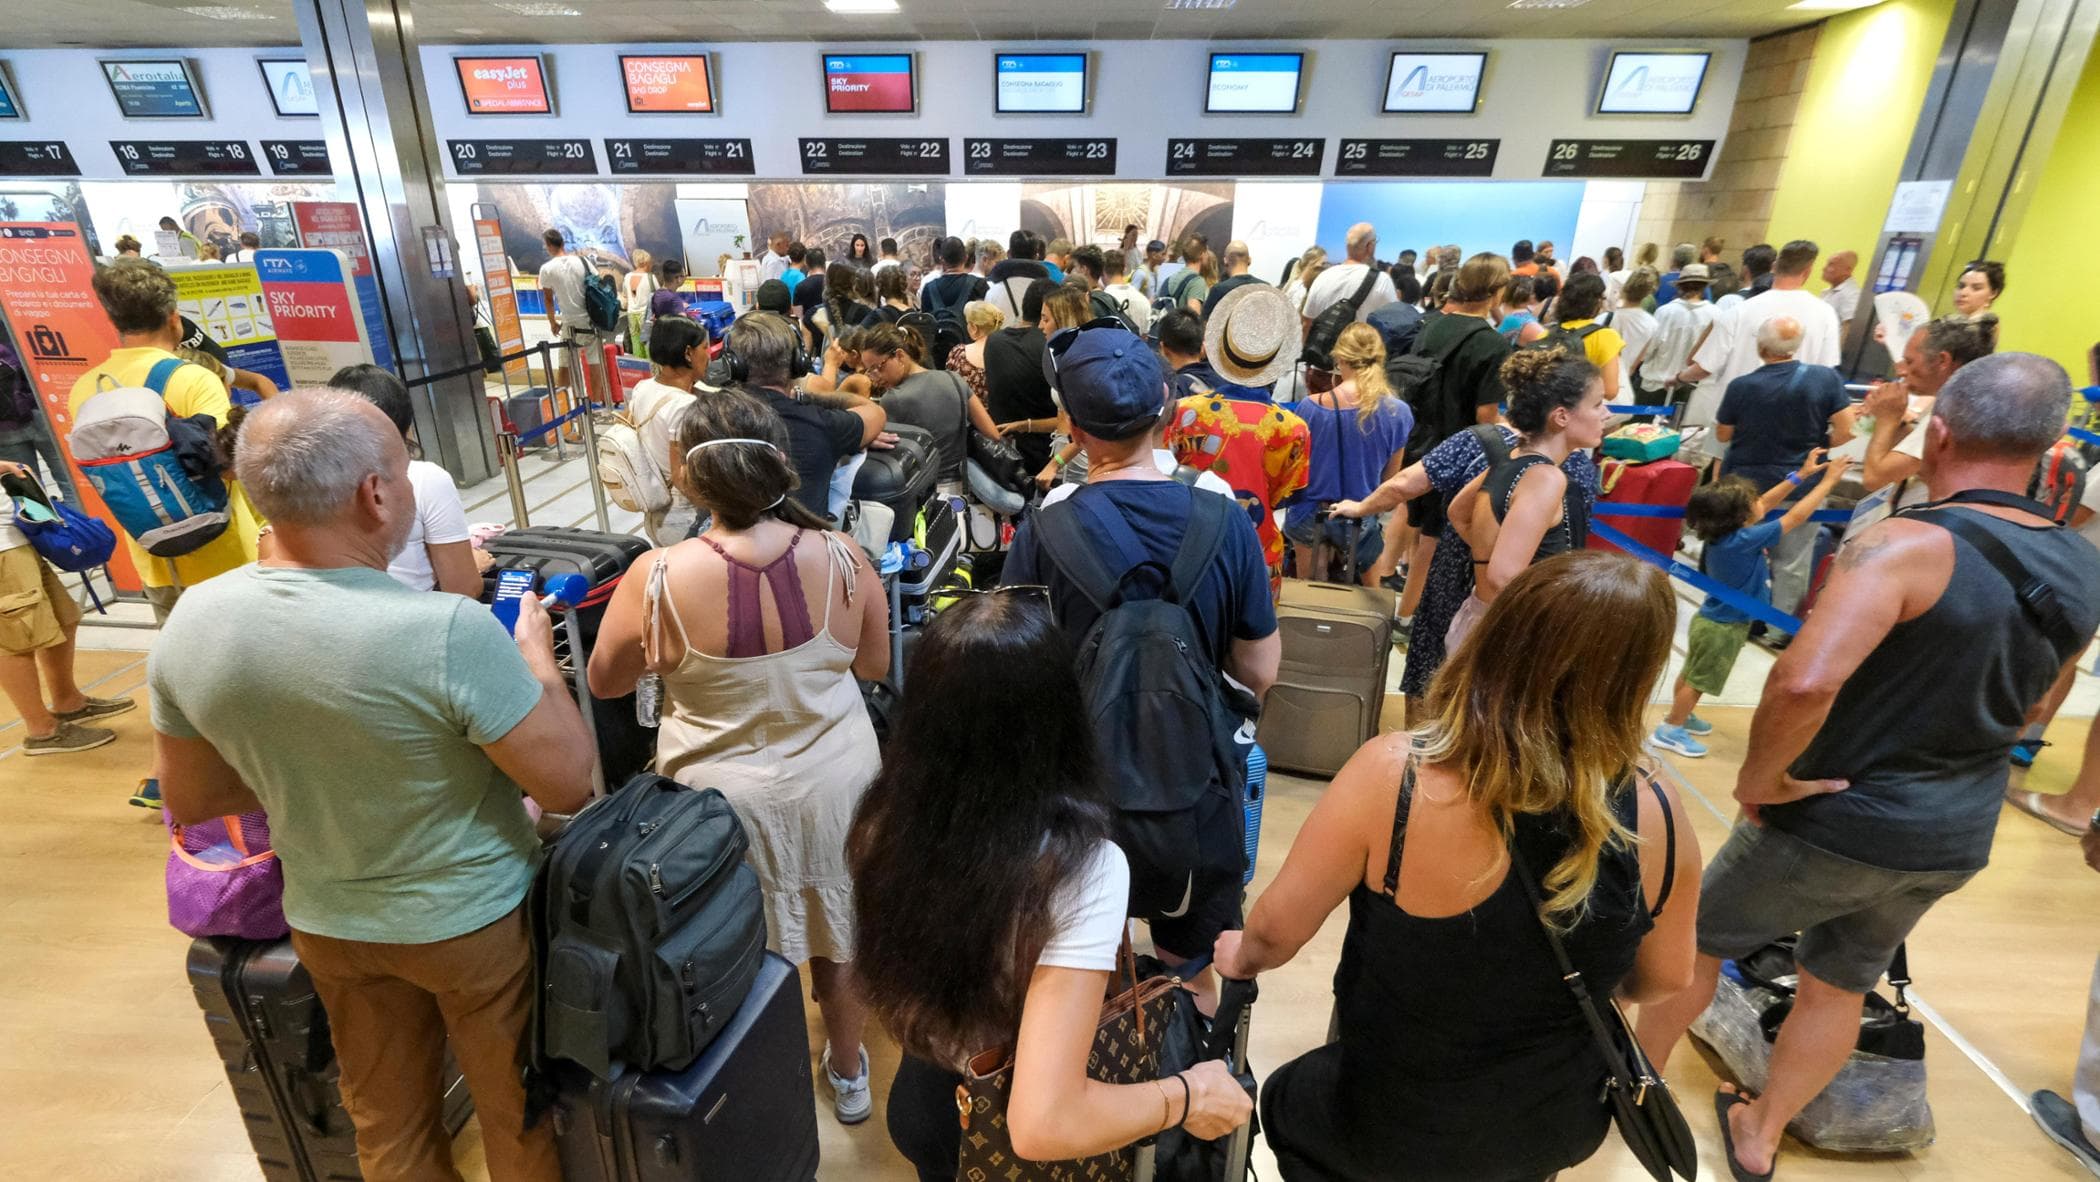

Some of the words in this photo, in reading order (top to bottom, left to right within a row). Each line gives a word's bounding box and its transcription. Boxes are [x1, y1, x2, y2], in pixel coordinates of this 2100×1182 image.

[474, 66, 528, 82] easyJet
[626, 62, 691, 72] CONSEGNA
[507, 80, 527, 90] plus
[629, 73, 677, 84] BAGAGLI
[45, 145, 62, 159] 17
[119, 145, 139, 160] 18
[226, 144, 245, 159] 18
[270, 144, 288, 159] 19
[456, 144, 476, 159] 20
[564, 143, 584, 158] 20
[614, 143, 632, 157] 21
[726, 142, 743, 157] 21
[806, 142, 827, 157] 22
[920, 142, 940, 157] 22
[971, 142, 991, 157] 23
[1086, 143, 1107, 158] 23
[1174, 143, 1195, 158] 24
[1292, 142, 1314, 158] 24
[1344, 143, 1367, 158] 25
[1464, 143, 1489, 159] 25
[1553, 144, 1578, 159] 26
[1676, 144, 1702, 160] 26
[0, 248, 84, 265] ONSEGNA
[263, 259, 292, 268] ITA
[0, 266, 67, 283] BAGAGLI
[270, 292, 295, 305] SKY
[274, 305, 336, 318] PRIORITY
